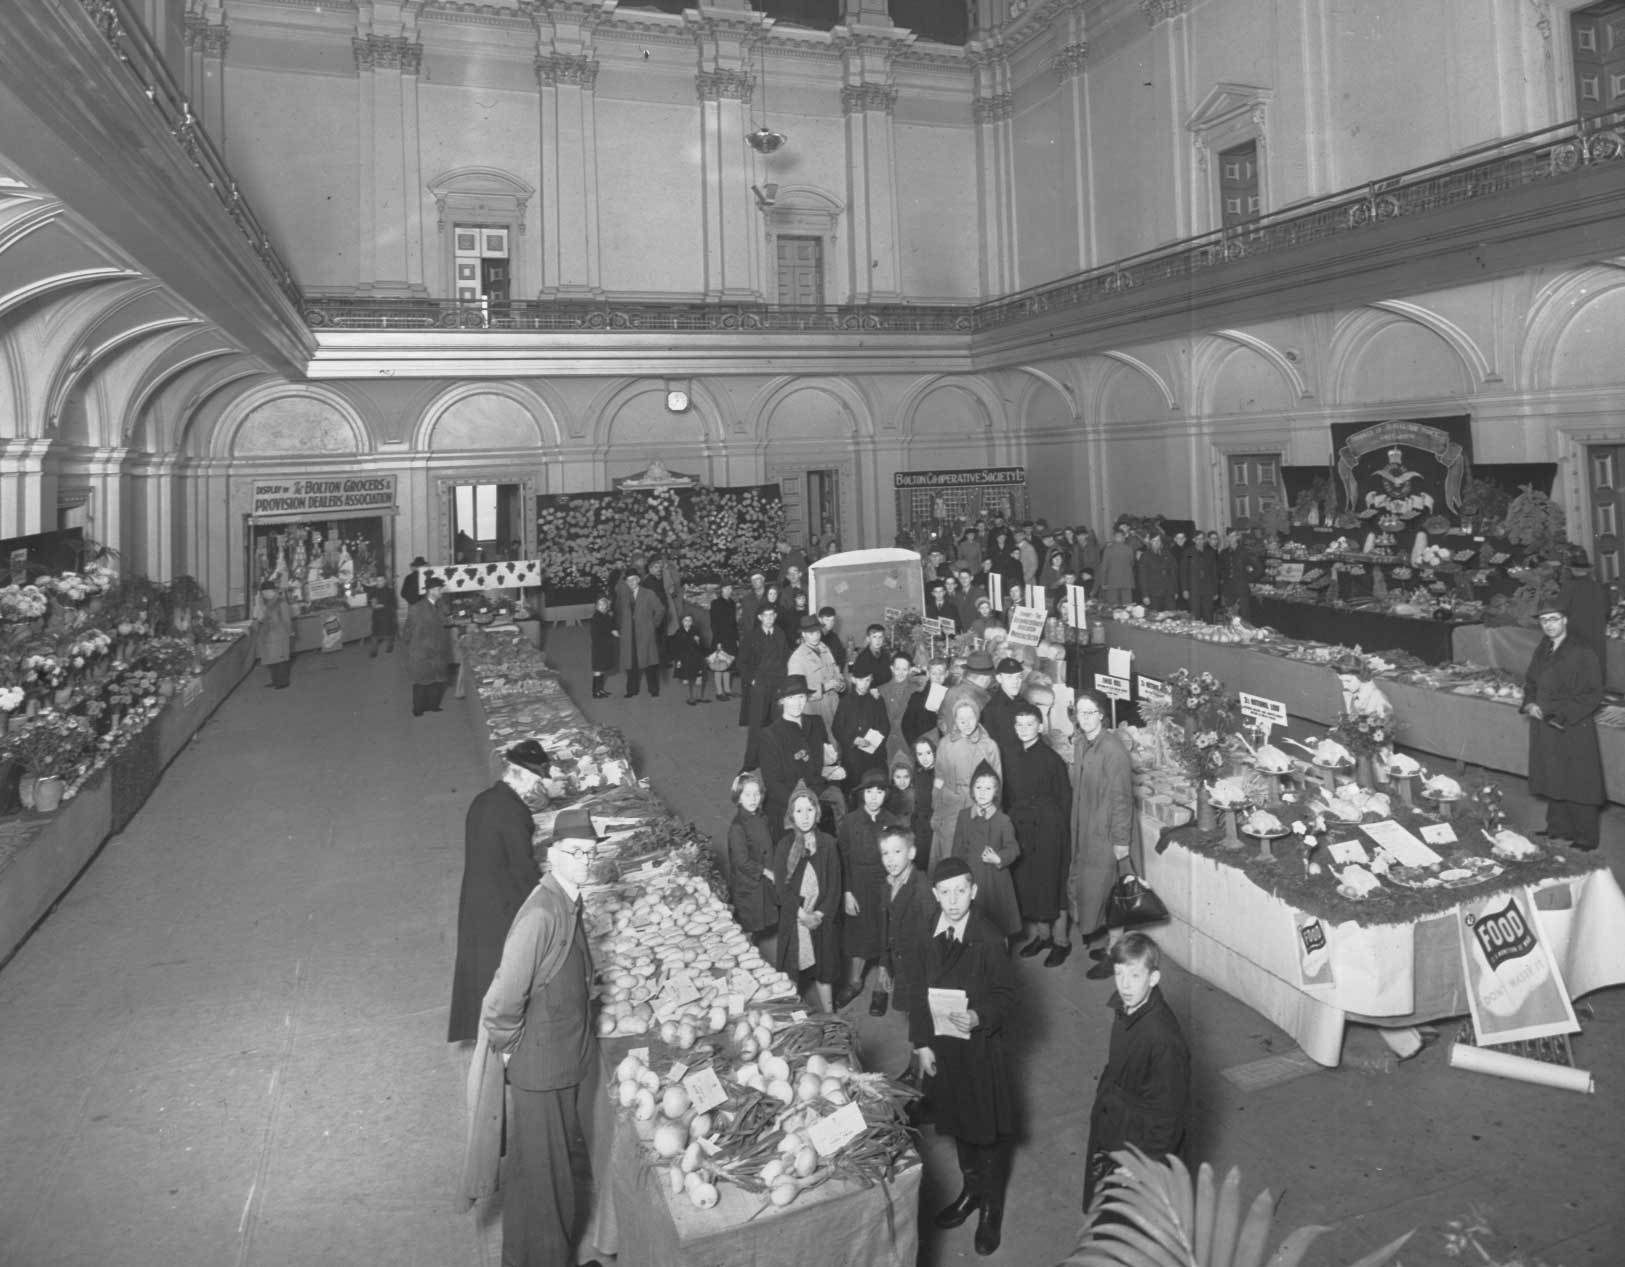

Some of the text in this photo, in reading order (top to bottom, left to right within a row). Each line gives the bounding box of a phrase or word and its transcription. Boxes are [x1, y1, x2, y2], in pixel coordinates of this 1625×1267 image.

[256, 485, 281, 496] DISPLAY
[304, 480, 341, 495] BOLTON
[343, 479, 385, 493] GROCERS
[895, 473, 925, 486] BOLTON
[982, 469, 1016, 483] SOCIETY
[255, 492, 393, 512] PROVISION DEALERS ASSOCIATION
[1303, 925, 1322, 946] FOOD
[1477, 909, 1525, 952] FOOD
